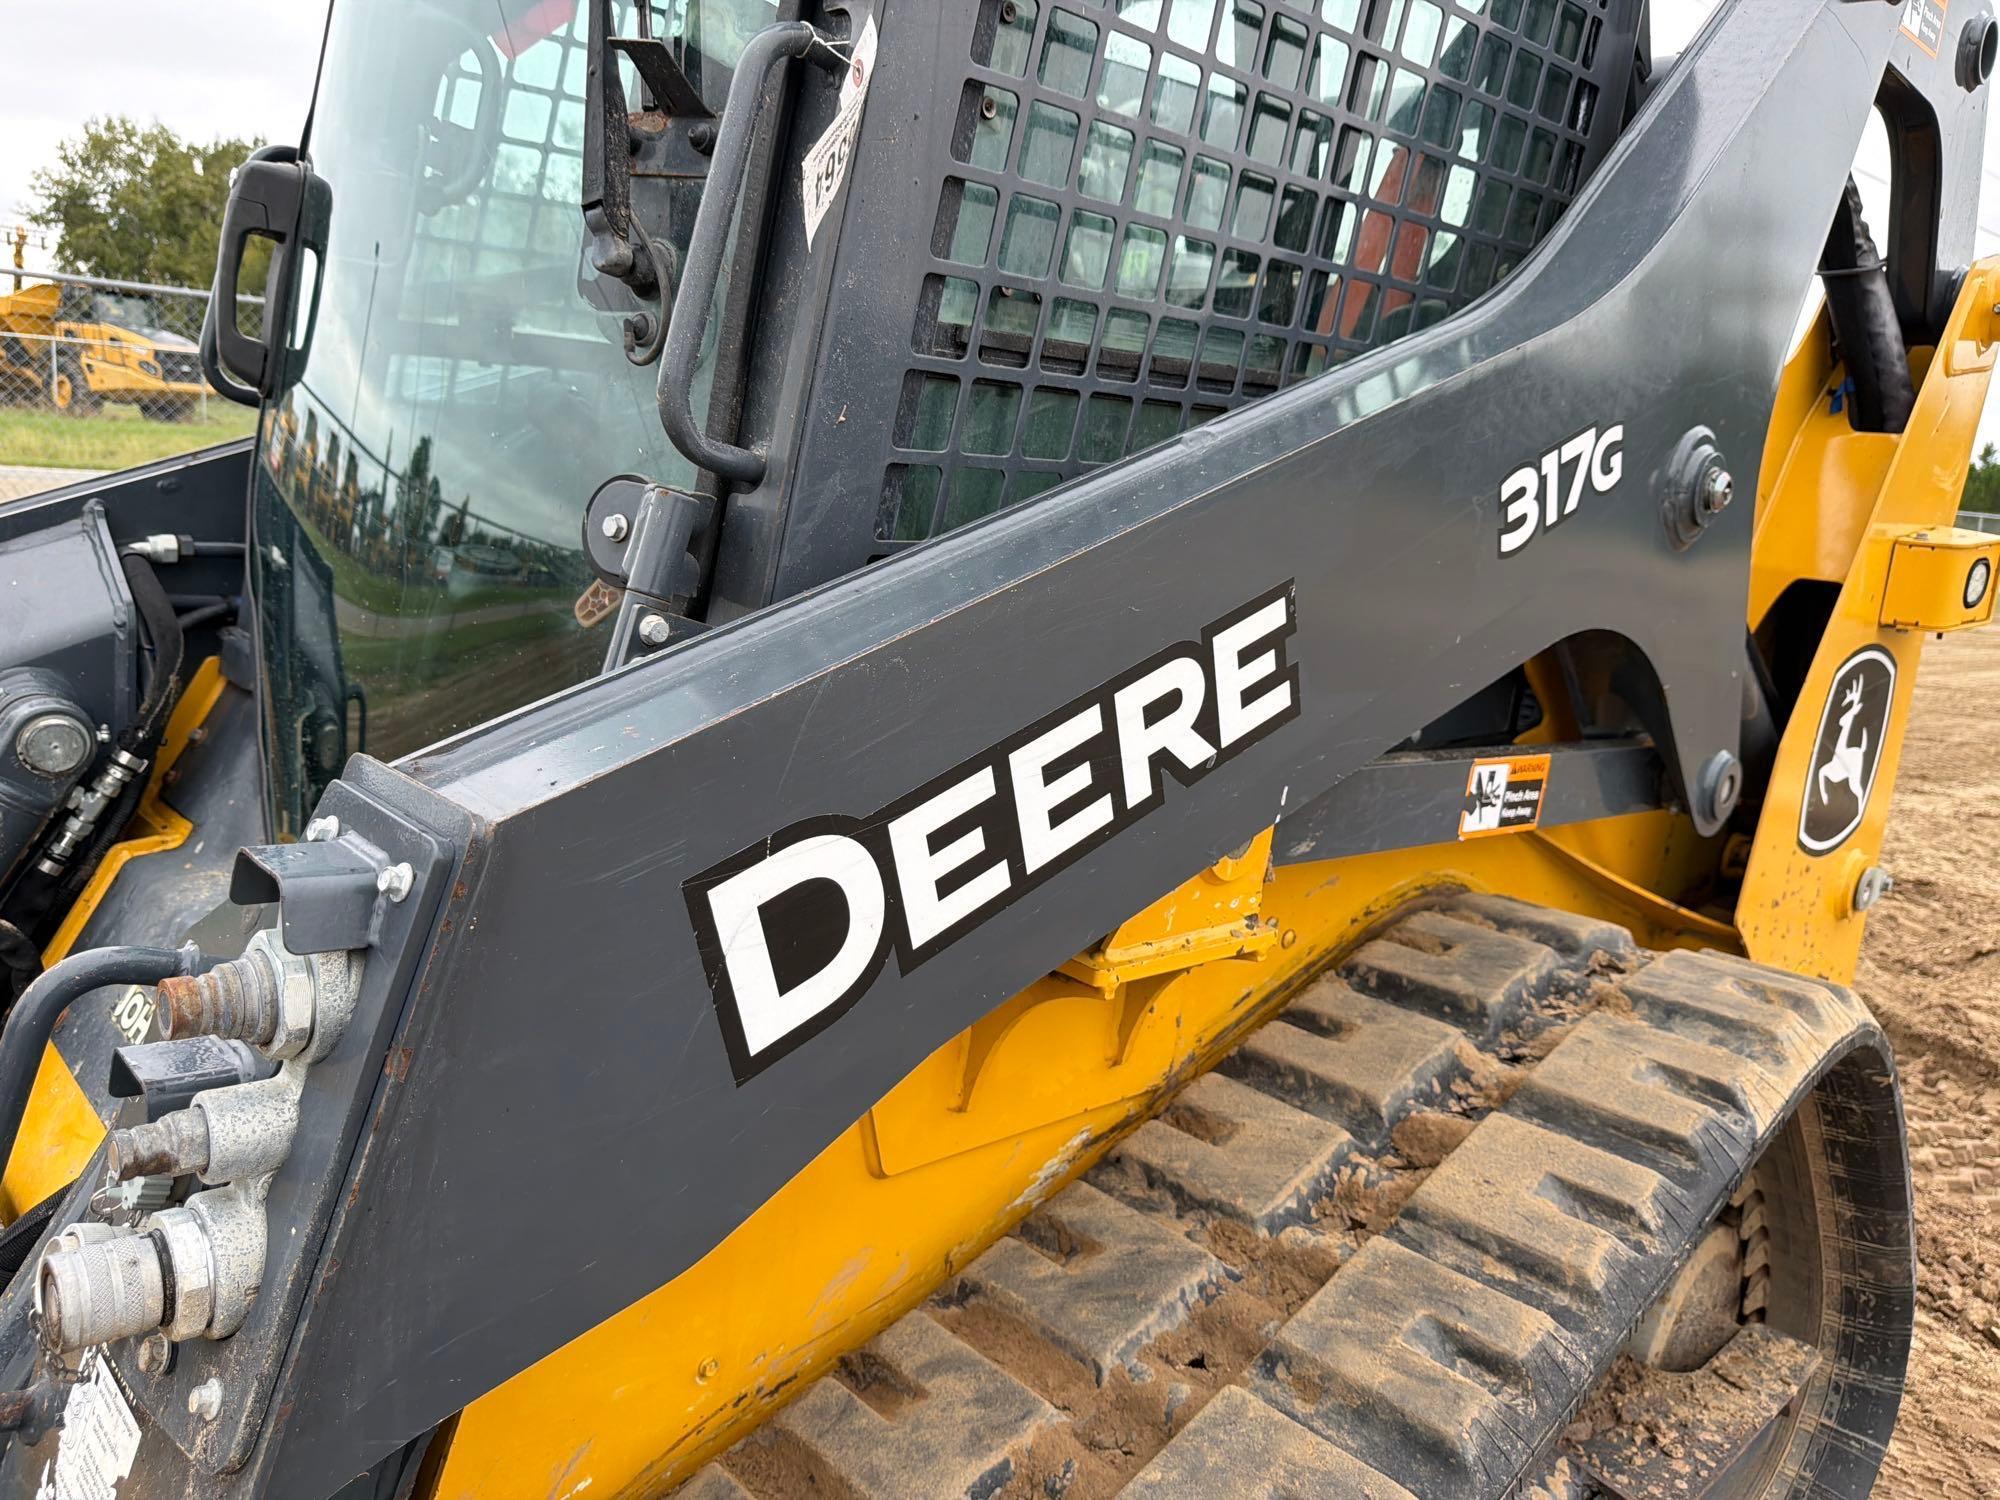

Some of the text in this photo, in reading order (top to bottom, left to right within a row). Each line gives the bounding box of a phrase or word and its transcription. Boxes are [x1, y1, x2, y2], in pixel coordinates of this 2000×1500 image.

[1501, 424, 1624, 553] 317G
[706, 596, 1292, 1058] DEERE
[1504, 789, 1539, 802] Pinch Area
[113, 984, 156, 1045] JOH
